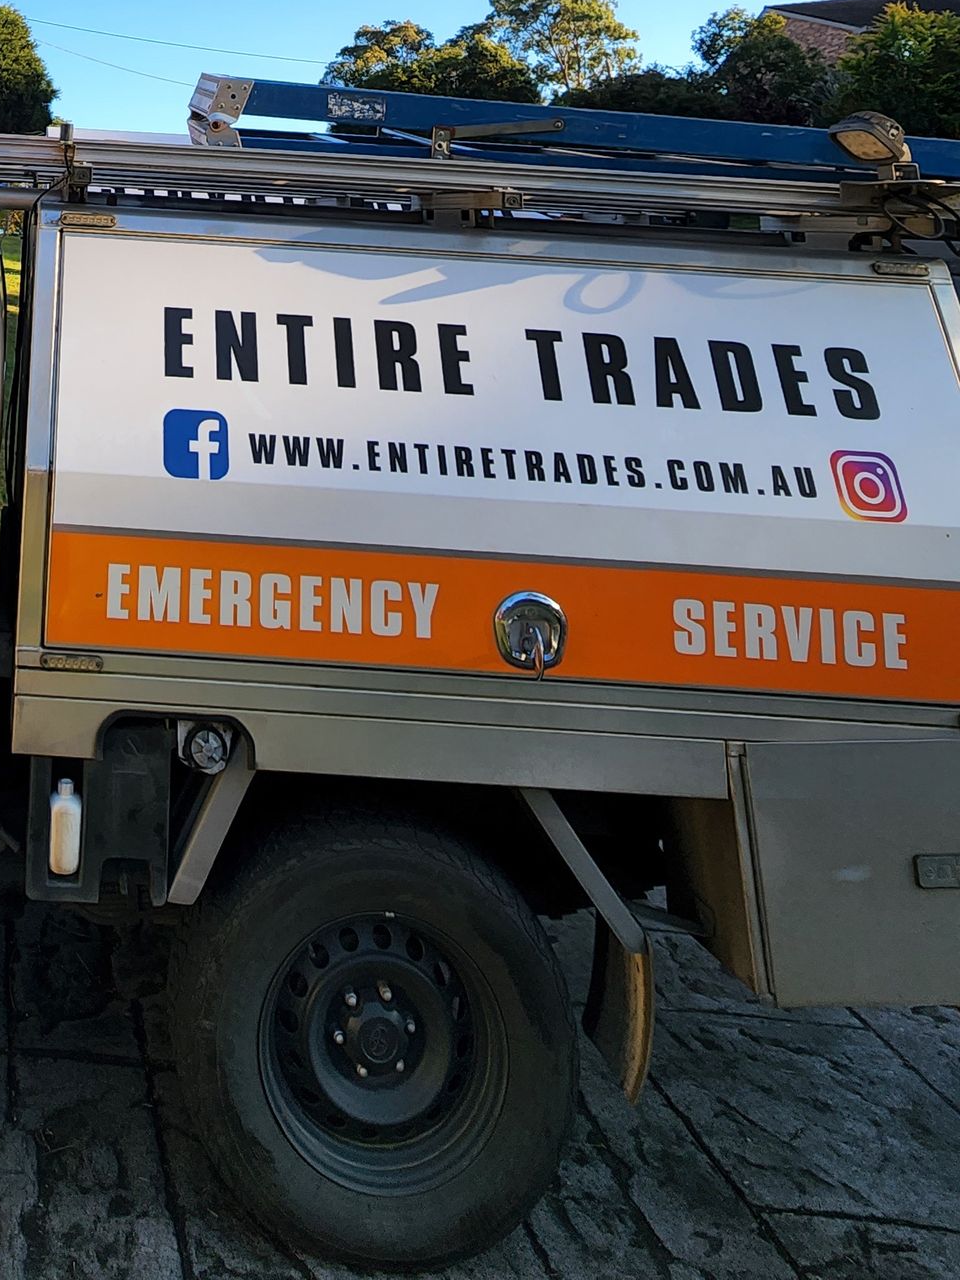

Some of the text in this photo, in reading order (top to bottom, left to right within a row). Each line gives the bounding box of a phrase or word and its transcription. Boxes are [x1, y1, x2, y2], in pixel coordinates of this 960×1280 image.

[164, 306, 881, 420] ENTIRE TRADES
[248, 433, 819, 499] WWW.ENTIRETRADES.COM.AU
[106, 562, 909, 670] EMERGENCY SERVICE
